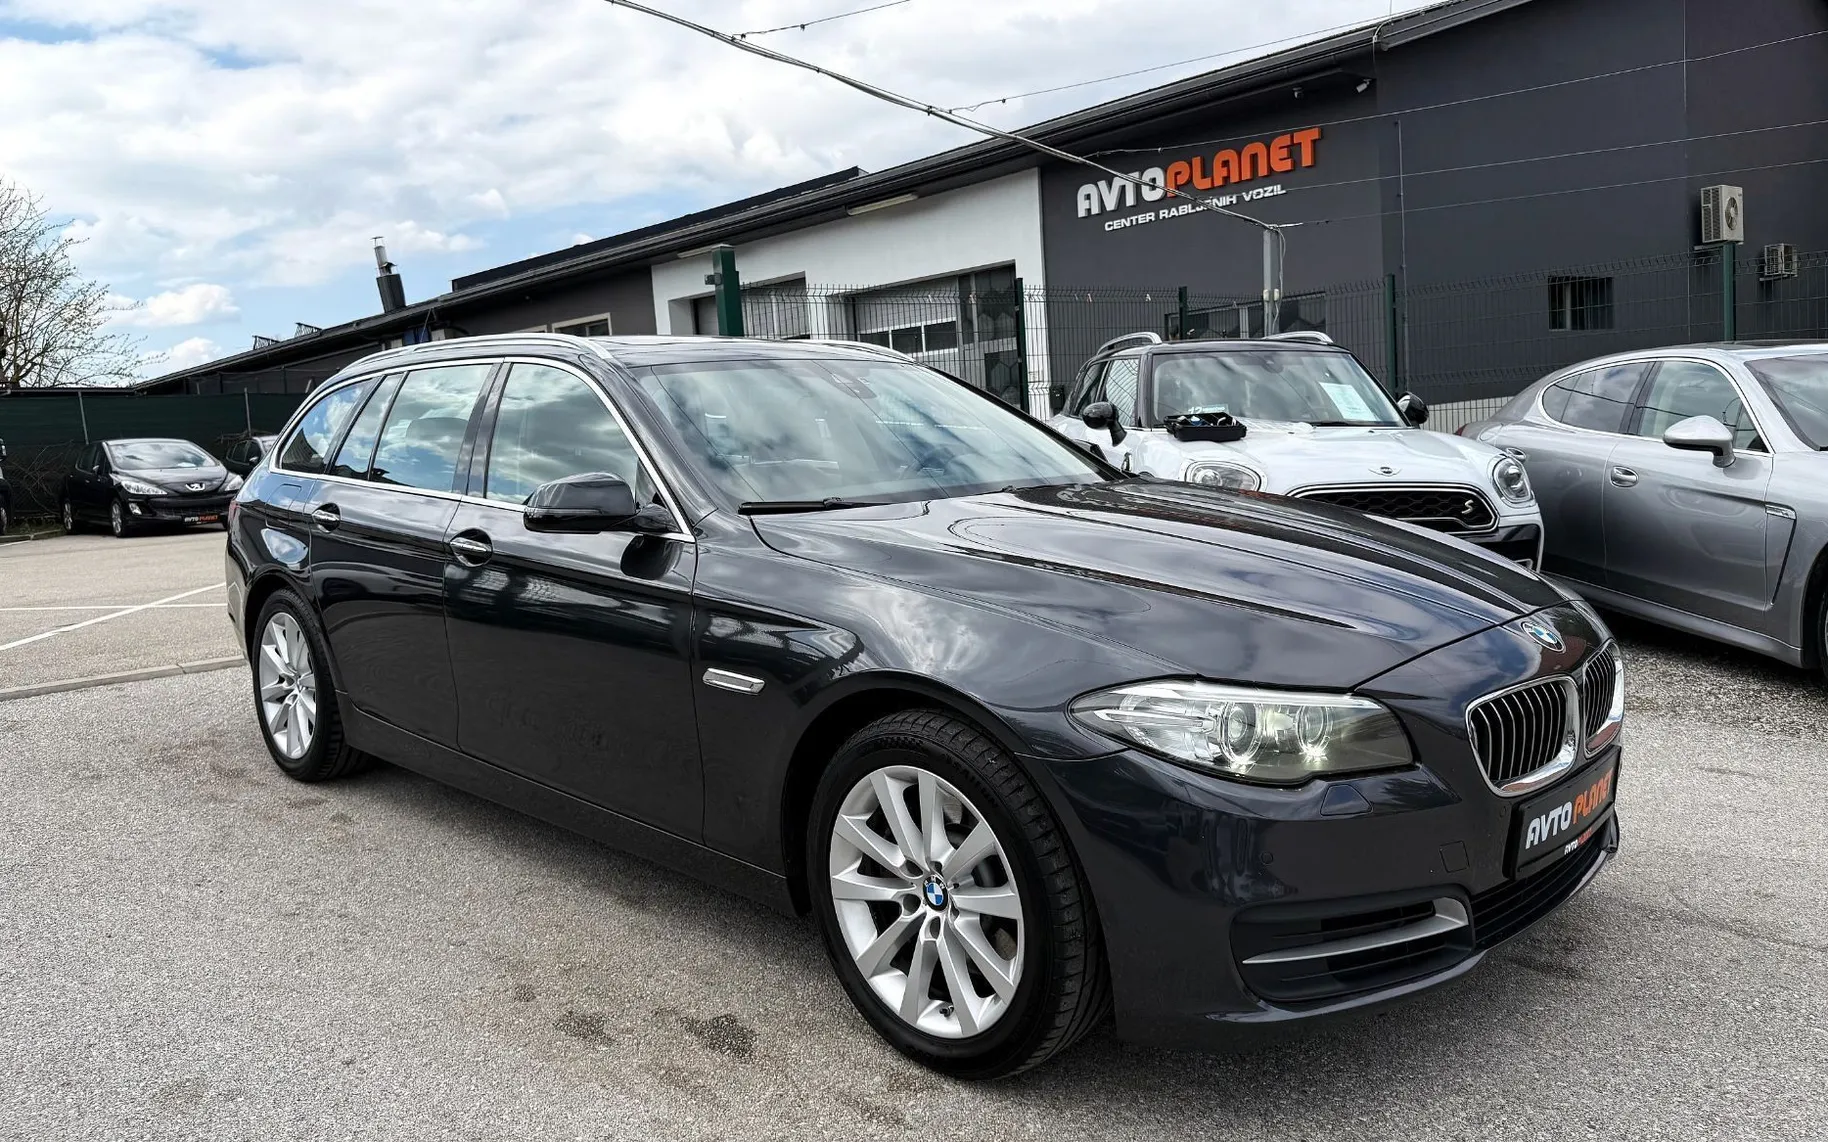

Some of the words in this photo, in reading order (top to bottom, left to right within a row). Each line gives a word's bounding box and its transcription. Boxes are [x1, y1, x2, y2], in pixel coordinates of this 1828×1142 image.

[1077, 127, 1321, 217] AVTOPLANET
[1104, 211, 1155, 231] CENTER
[1242, 184, 1287, 202] VOZIL
[1461, 499, 1474, 514] S
